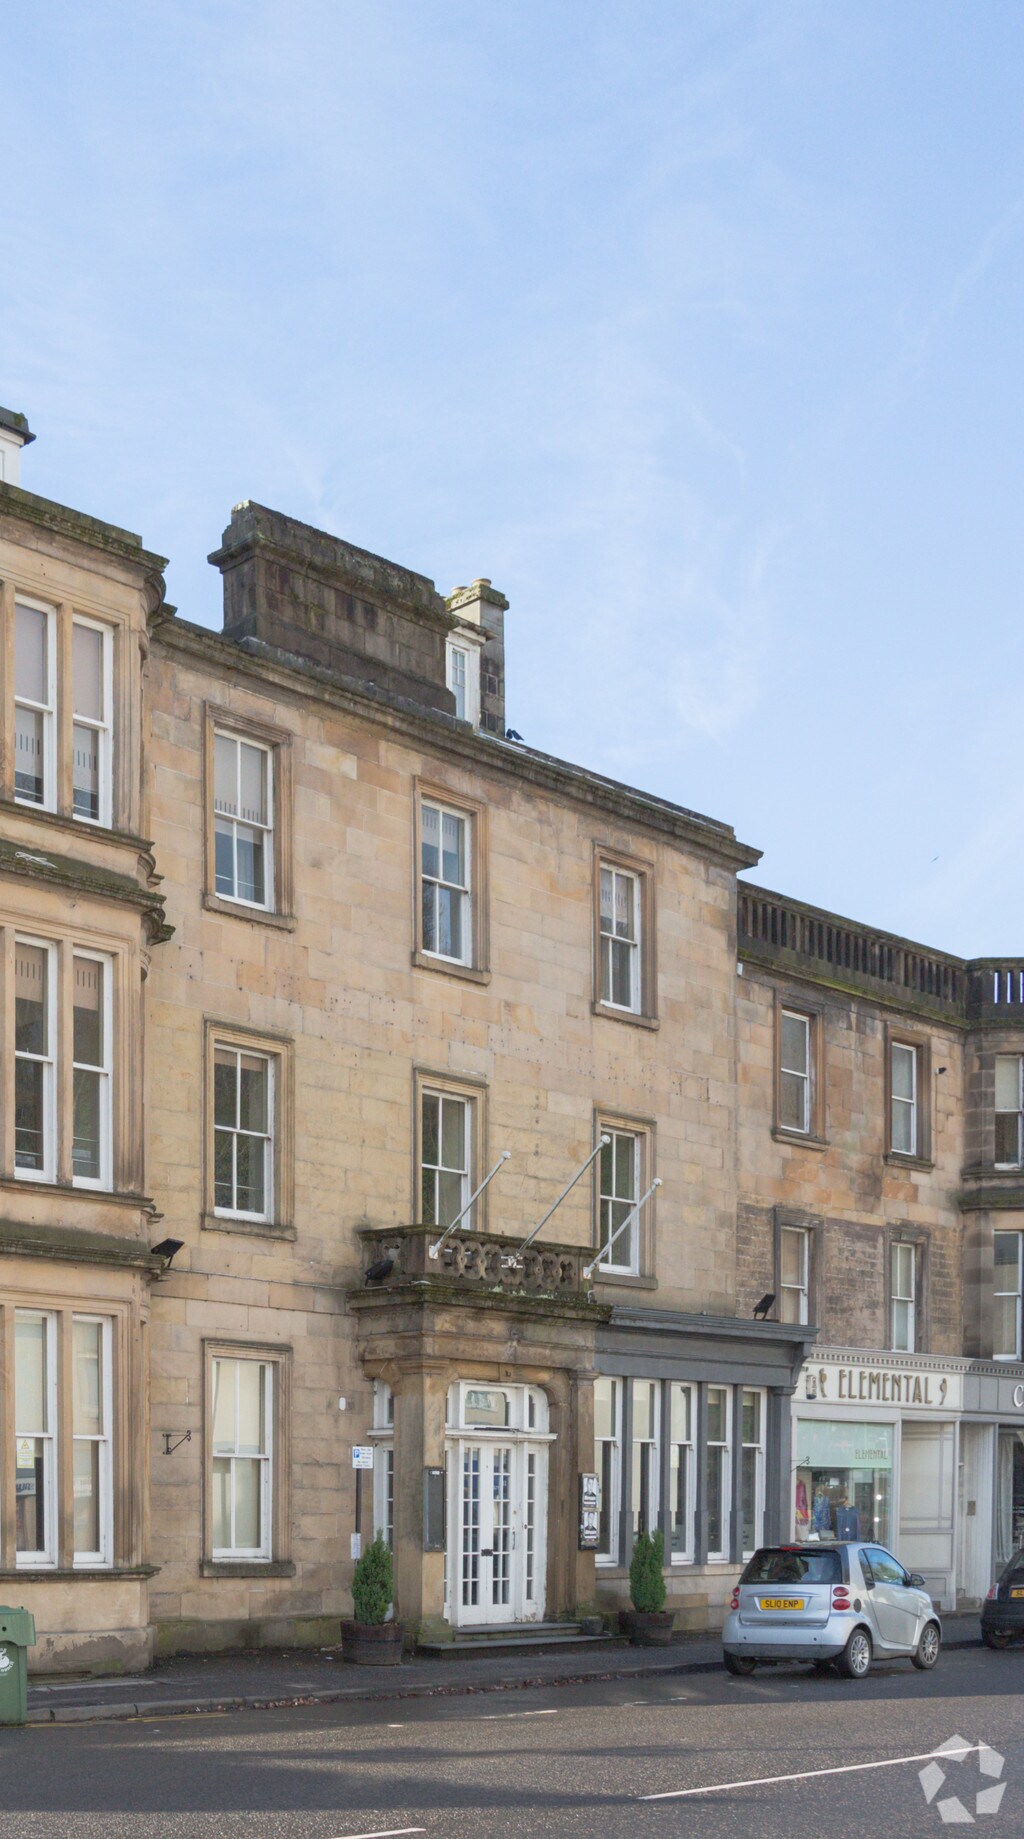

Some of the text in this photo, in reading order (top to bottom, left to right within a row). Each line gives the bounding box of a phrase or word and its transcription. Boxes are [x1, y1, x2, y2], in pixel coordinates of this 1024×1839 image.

[838, 1369, 933, 1404] ELEMENTAL
[855, 1449, 888, 1460] ELEMENTAL
[765, 1600, 799, 1608] SL10 ENP
